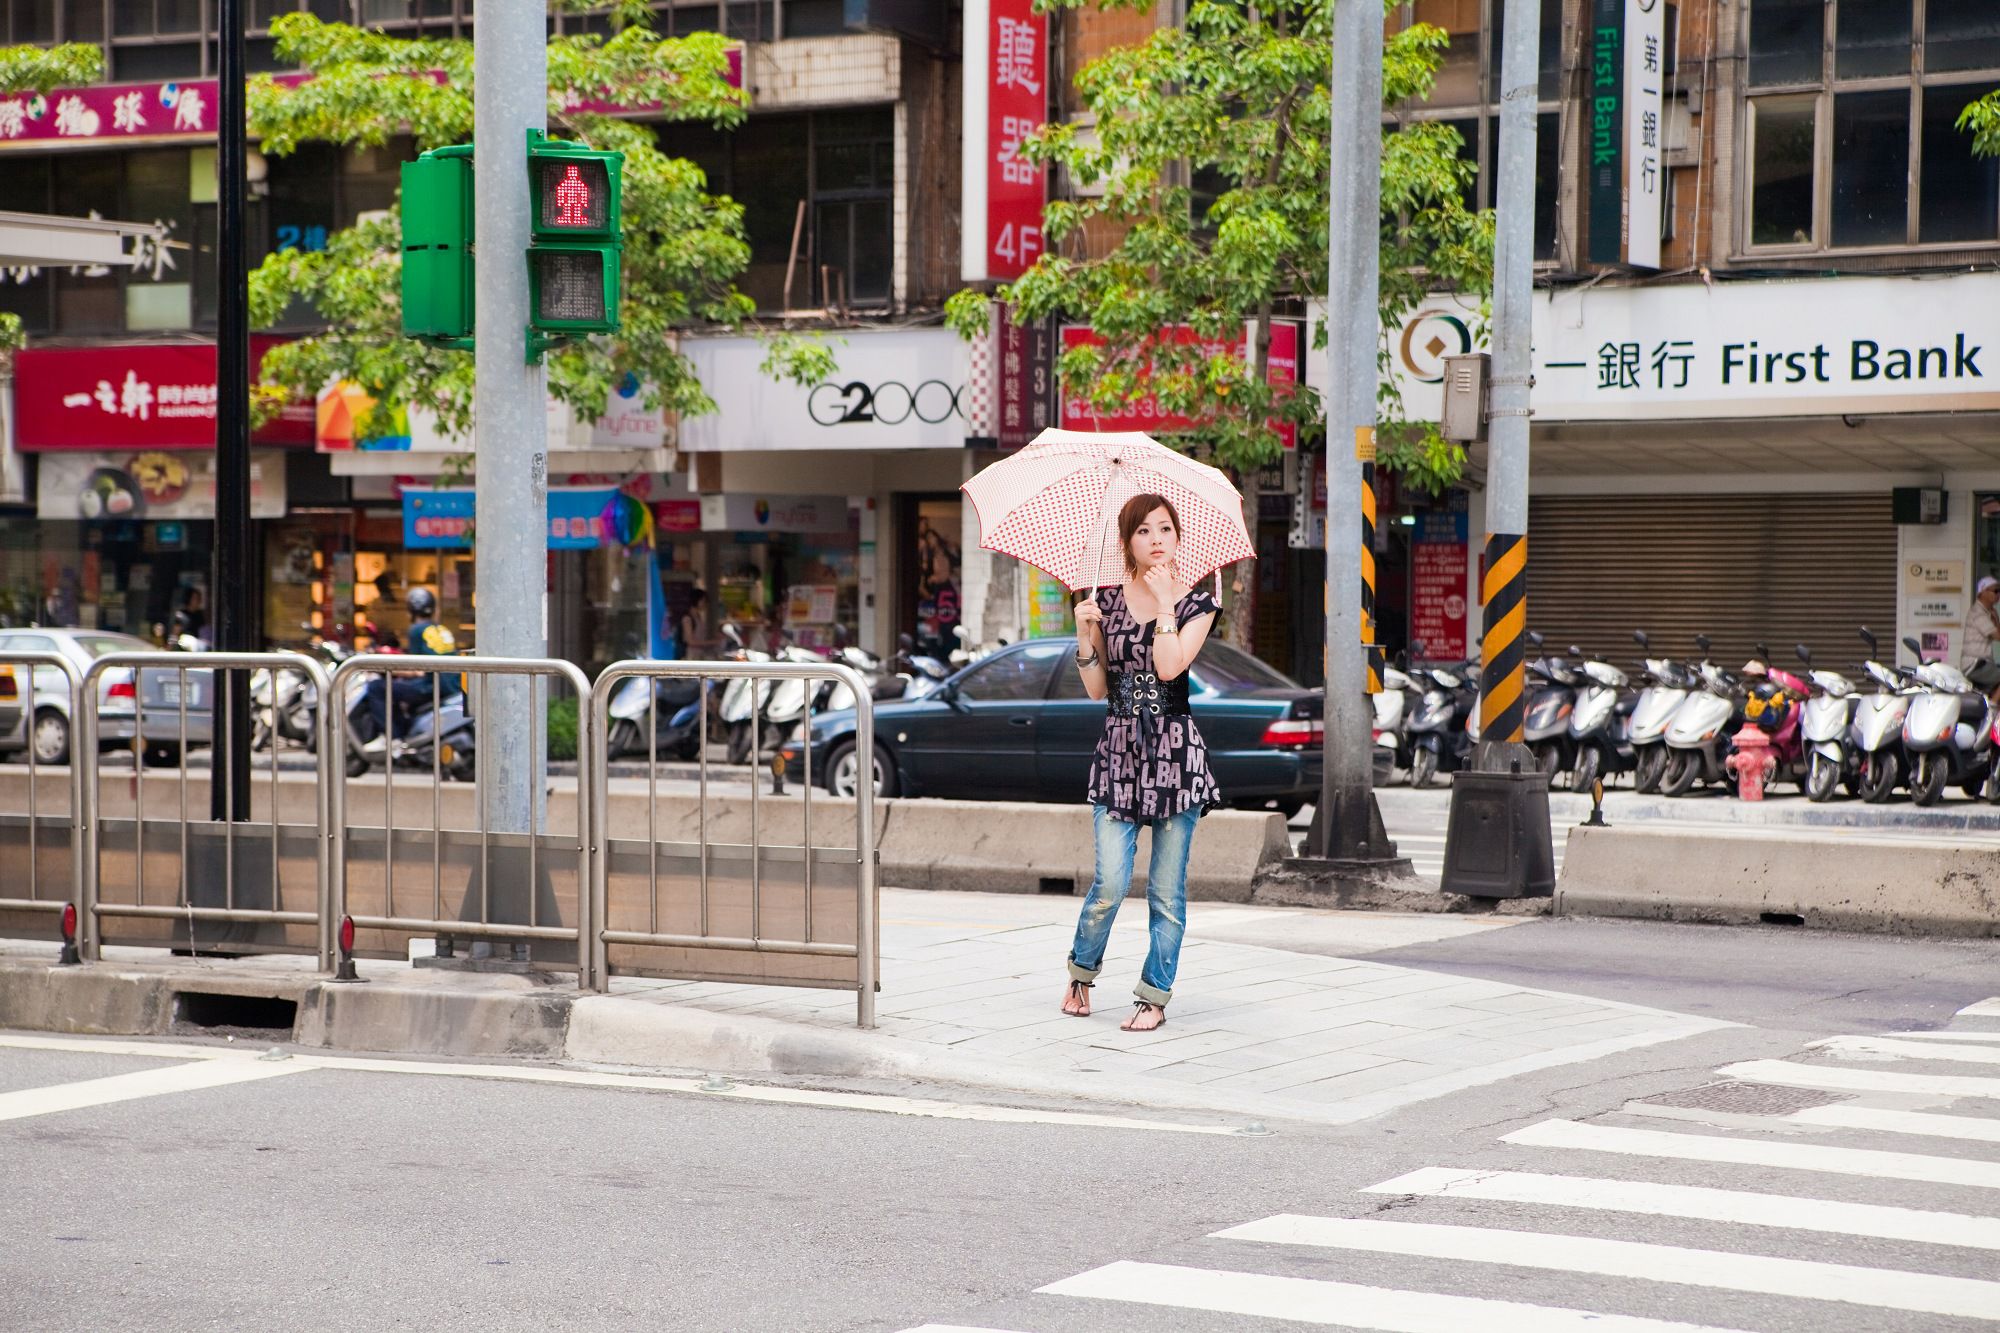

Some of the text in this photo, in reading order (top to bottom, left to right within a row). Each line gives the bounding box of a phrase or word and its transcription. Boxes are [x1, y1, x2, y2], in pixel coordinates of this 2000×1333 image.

[996, 16, 1041, 185] 聽器
[1594, 27, 1618, 164] First Bank
[1641, 34, 1659, 194] 第一銀行
[995, 222, 1039, 267] 4F
[1531, 342, 1695, 390] 一銀行
[1722, 333, 1984, 385] First Bank
